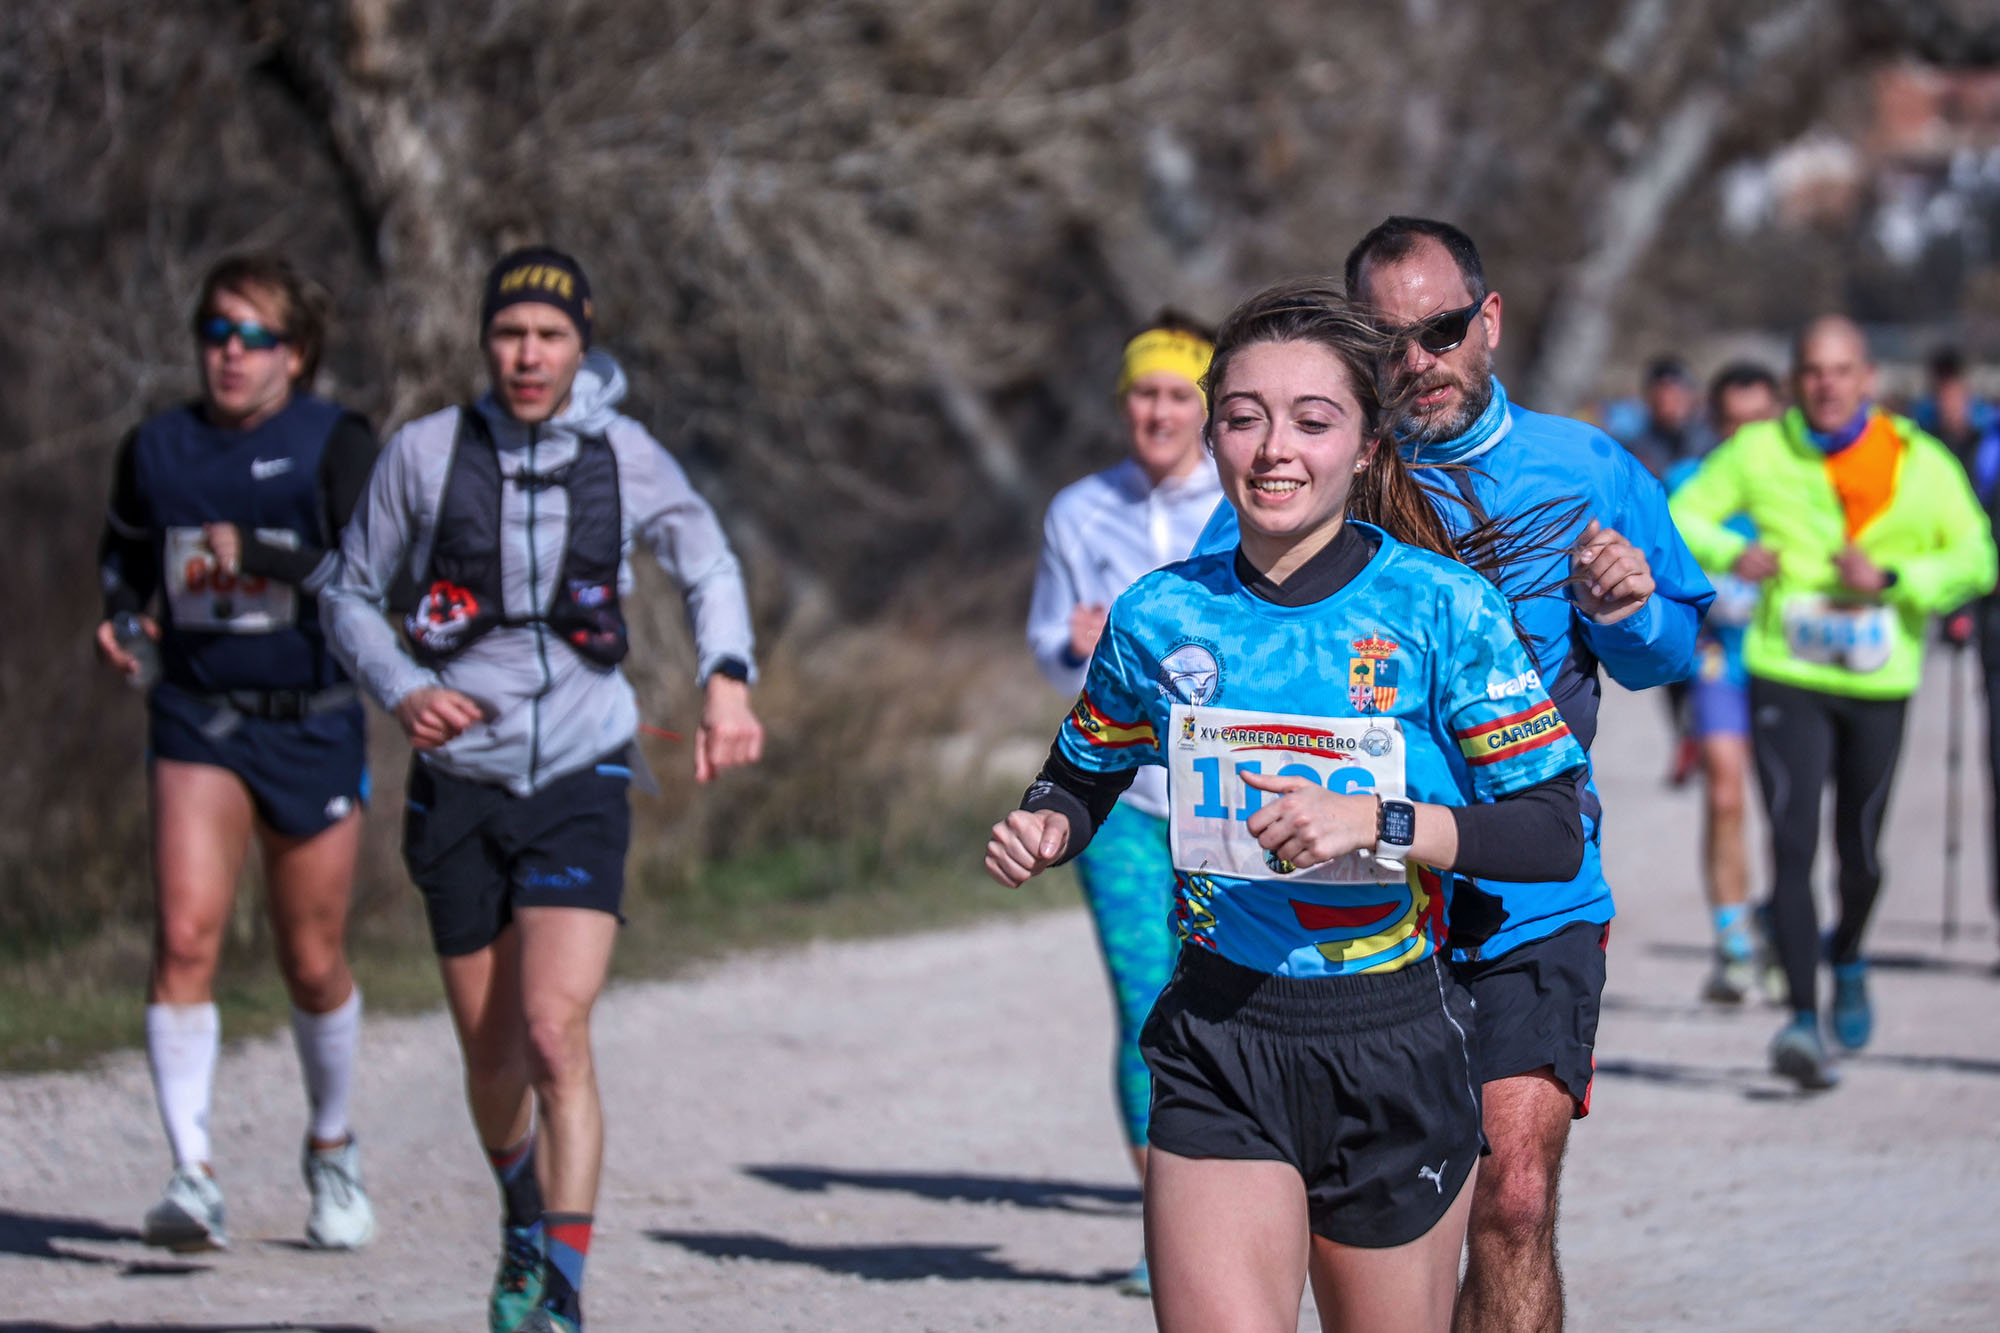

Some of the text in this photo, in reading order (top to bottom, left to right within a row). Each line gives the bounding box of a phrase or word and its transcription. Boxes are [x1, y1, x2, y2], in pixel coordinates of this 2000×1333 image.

[1200, 727, 1218, 740] XV
[1221, 728, 1284, 745] CARRERA
[1287, 734, 1313, 747] DEL
[1316, 736, 1356, 749] EBRO
[1487, 711, 1564, 749] CARRERA
